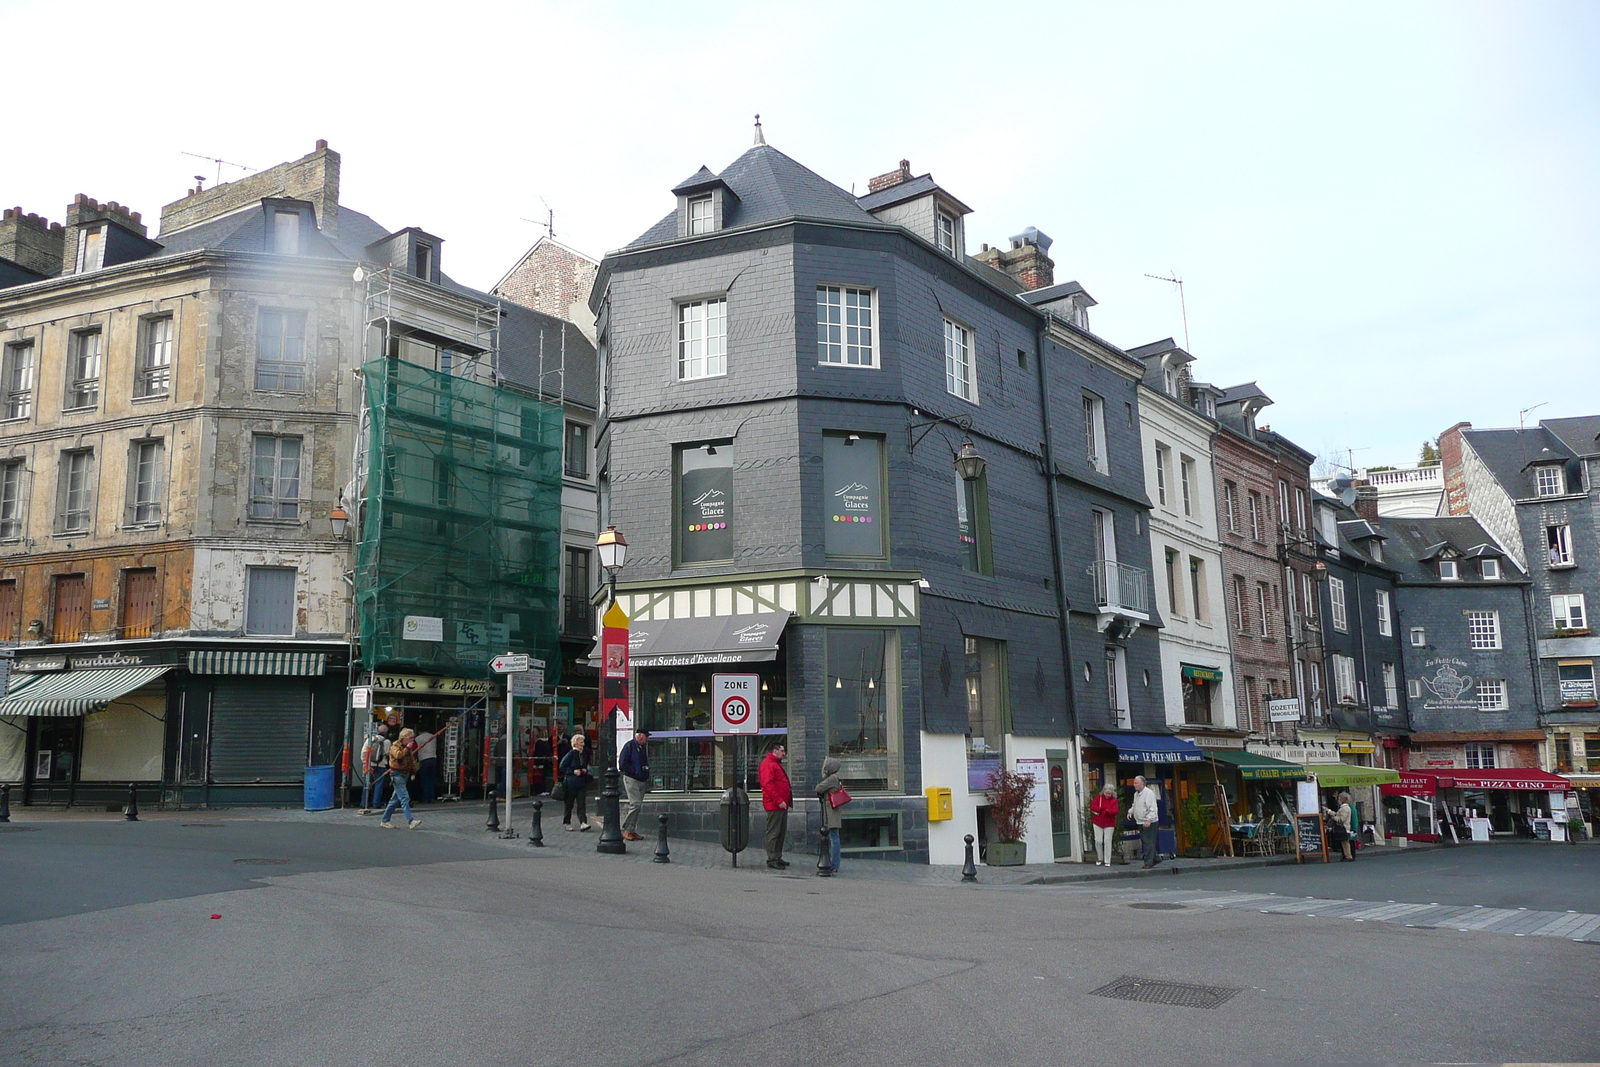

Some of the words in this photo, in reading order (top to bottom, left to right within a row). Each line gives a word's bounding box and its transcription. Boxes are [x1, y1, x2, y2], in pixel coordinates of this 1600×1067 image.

[844, 500, 869, 509] Glaces
[701, 508, 725, 516] Glaces
[628, 657, 648, 667] laces
[648, 656, 657, 666] et
[657, 655, 690, 666] Sorbets
[690, 652, 742, 665] d'Excellence
[365, 675, 416, 690] TABAC
[427, 678, 445, 690] Le
[724, 681, 749, 690] ZONE
[727, 704, 745, 716] 30
[1270, 703, 1299, 711] COZETTE
[1142, 752, 1151, 762] LE
[1480, 780, 1513, 788] PIZZA
[1516, 781, 1545, 789] GINO
